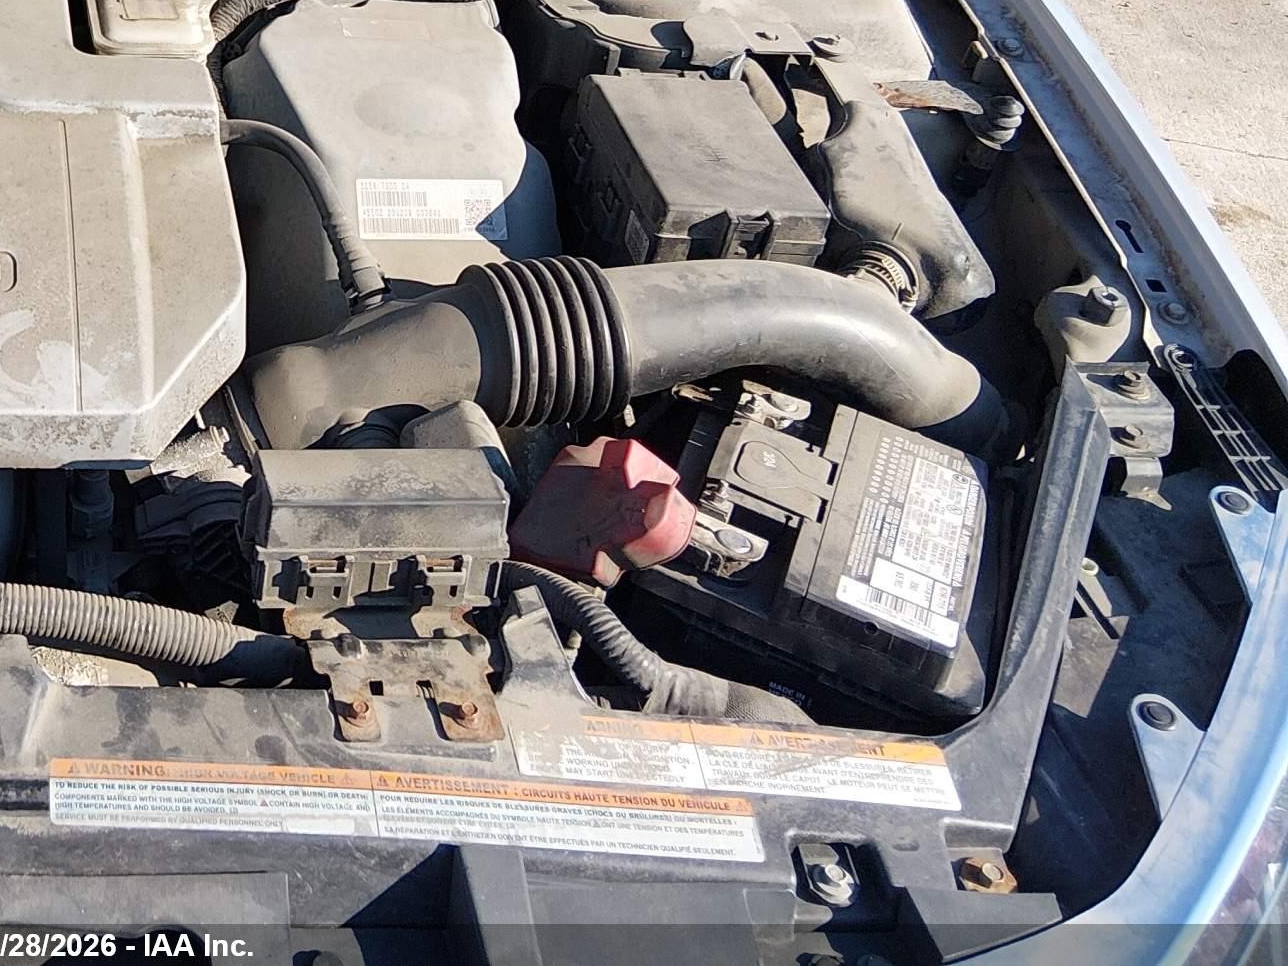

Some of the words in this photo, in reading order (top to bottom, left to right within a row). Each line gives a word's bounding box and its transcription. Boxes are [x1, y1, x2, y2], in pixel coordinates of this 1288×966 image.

[67, 782, 99, 791] REDUCE
[101, 783, 116, 792] THE
[118, 784, 136, 792] RISK
[138, 784, 148, 793] OF
[151, 785, 188, 794] POSSIBLE
[190, 786, 225, 796] SERIOUS
[226, 788, 255, 797] INJURY
[288, 790, 300, 799] OR
[328, 792, 339, 800] OR
[54, 793, 105, 803] COMPONENTS
[106, 795, 138, 804] MARKED
[139, 796, 157, 804] WITH
[158, 797, 173, 805] THE
[174, 797, 193, 806] HIGH
[194, 798, 226, 807] VOLTAGE
[521, 789, 572, 801] CIRCUITS
[574, 792, 610, 803] HAUTE
[612, 794, 659, 807] TENSION
[661, 798, 676, 808] DU
[74, 803, 132, 813] TEMPERATURES
[133, 805, 149, 813] AND
[151, 805, 180, 814] SHOULD
[268, 801, 301, 810] CONTAIN
[321, 802, 354, 812] VOLTAGE
